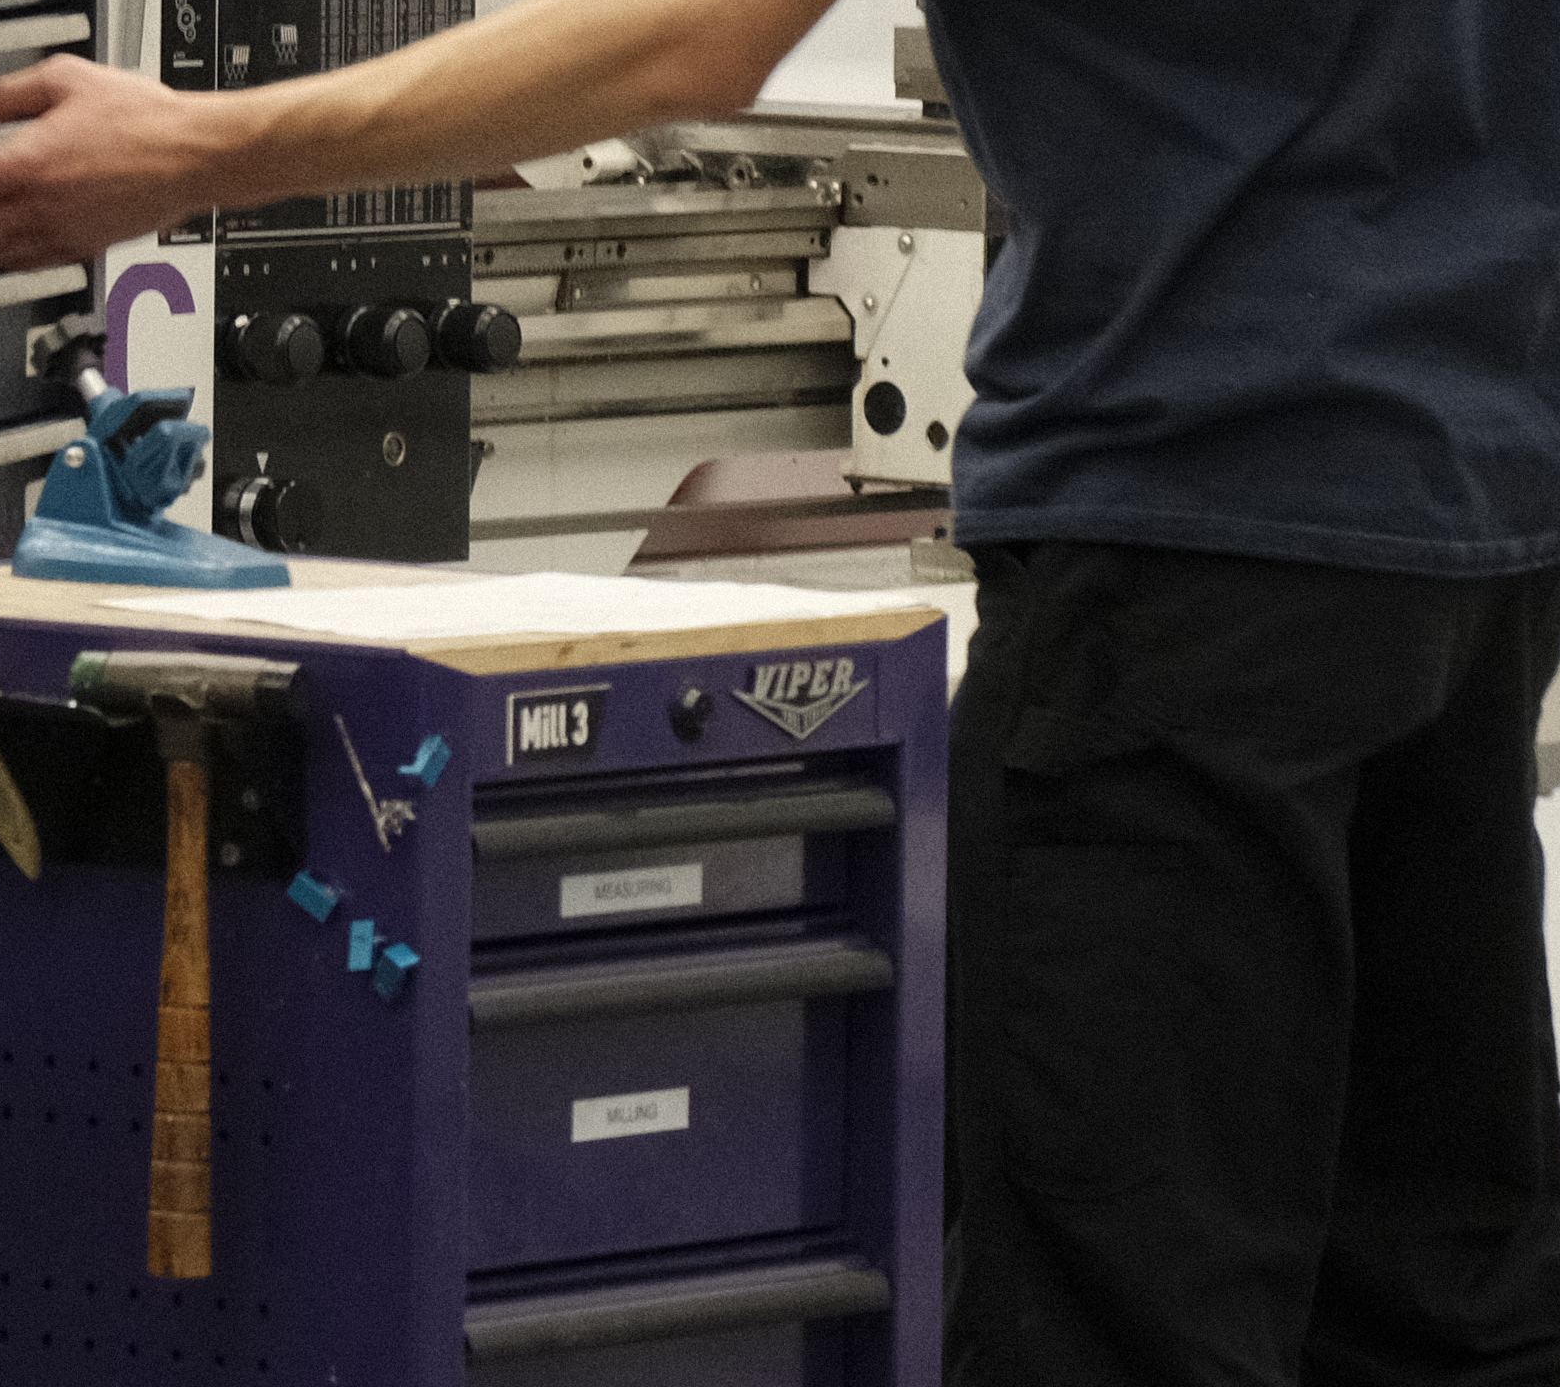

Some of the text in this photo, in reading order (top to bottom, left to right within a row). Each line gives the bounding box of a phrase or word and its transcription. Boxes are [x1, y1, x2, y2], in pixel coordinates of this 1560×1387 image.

[753, 658, 856, 703] VIPER
[519, 702, 590, 752] Mill 3
[593, 876, 674, 903] MEASURING
[605, 1100, 660, 1127] MILLING
